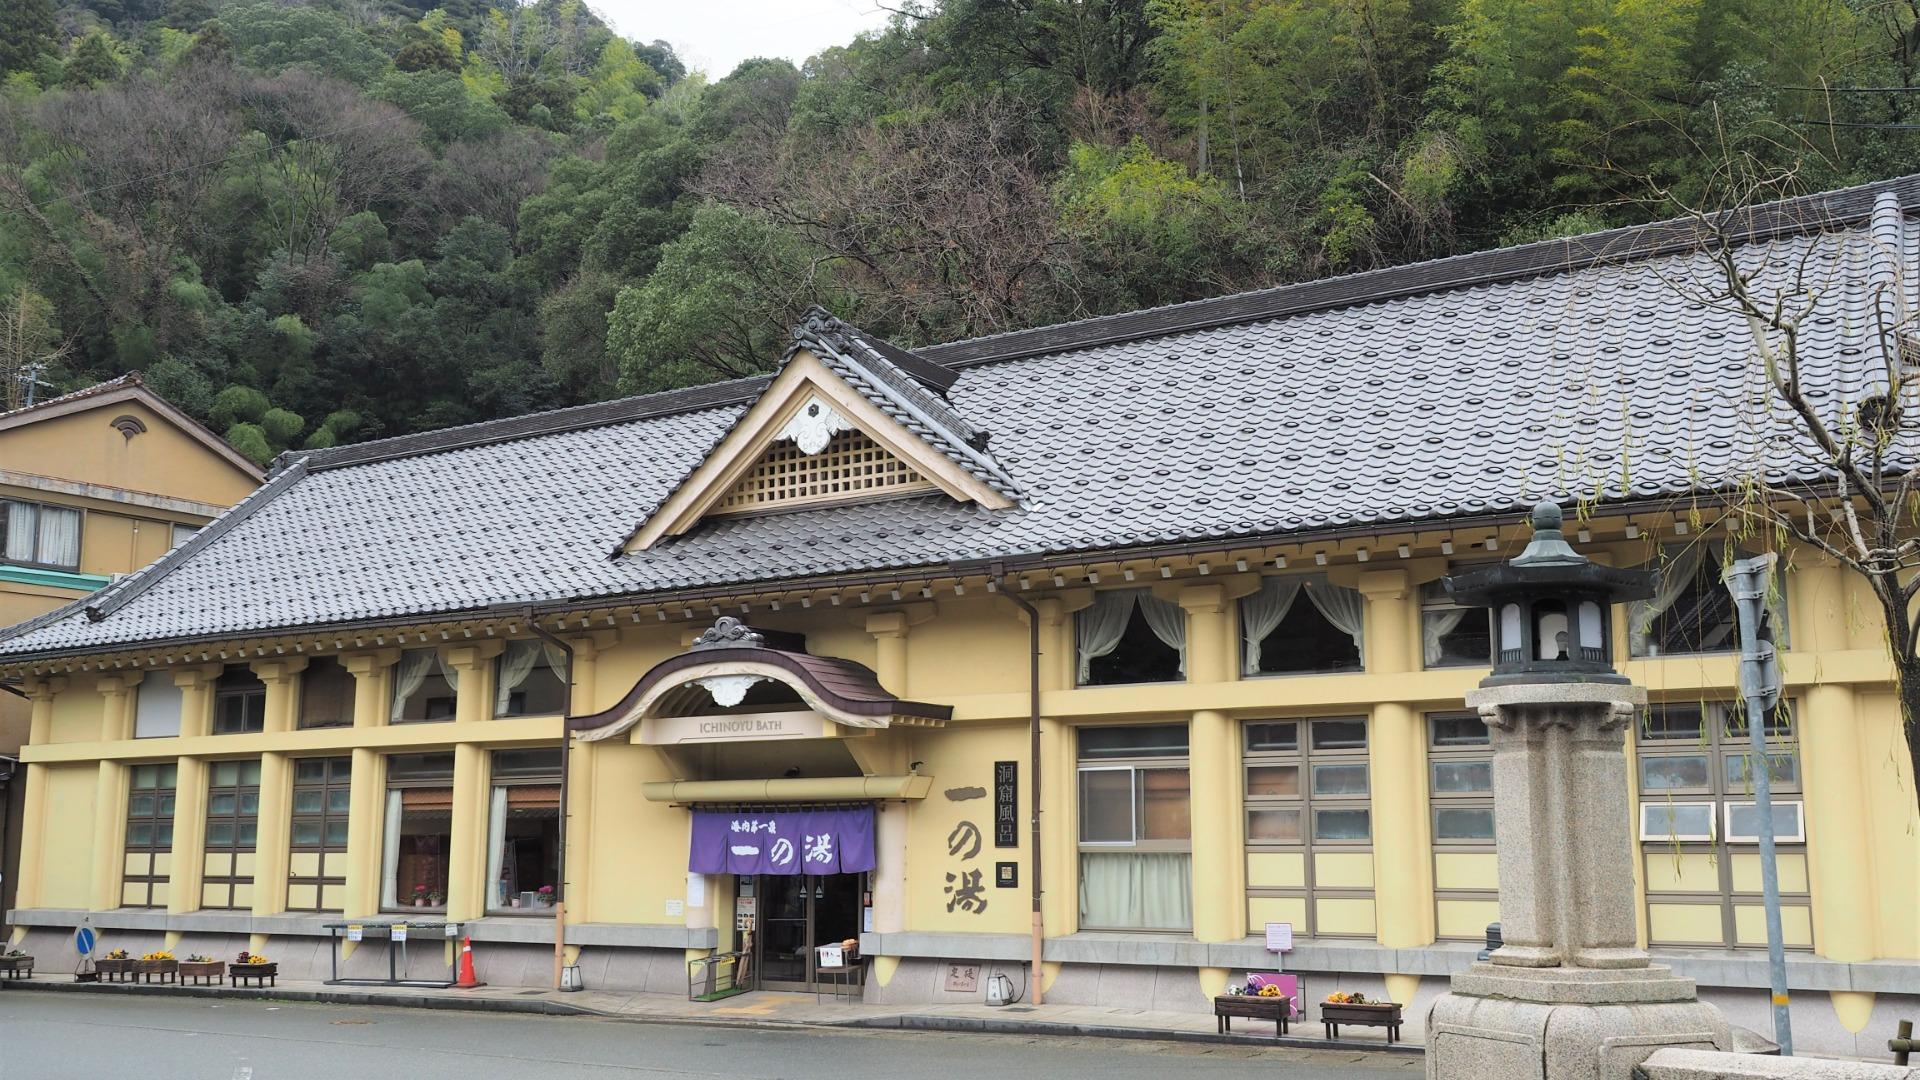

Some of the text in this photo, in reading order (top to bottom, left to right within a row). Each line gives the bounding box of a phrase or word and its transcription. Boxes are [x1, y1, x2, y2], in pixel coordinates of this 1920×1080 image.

[700, 721, 782, 733] ICHINOYU BATH
[999, 765, 1014, 842] 洞窟風呂
[730, 832, 833, 865] 一の湯
[944, 786, 987, 914] 一の湯
